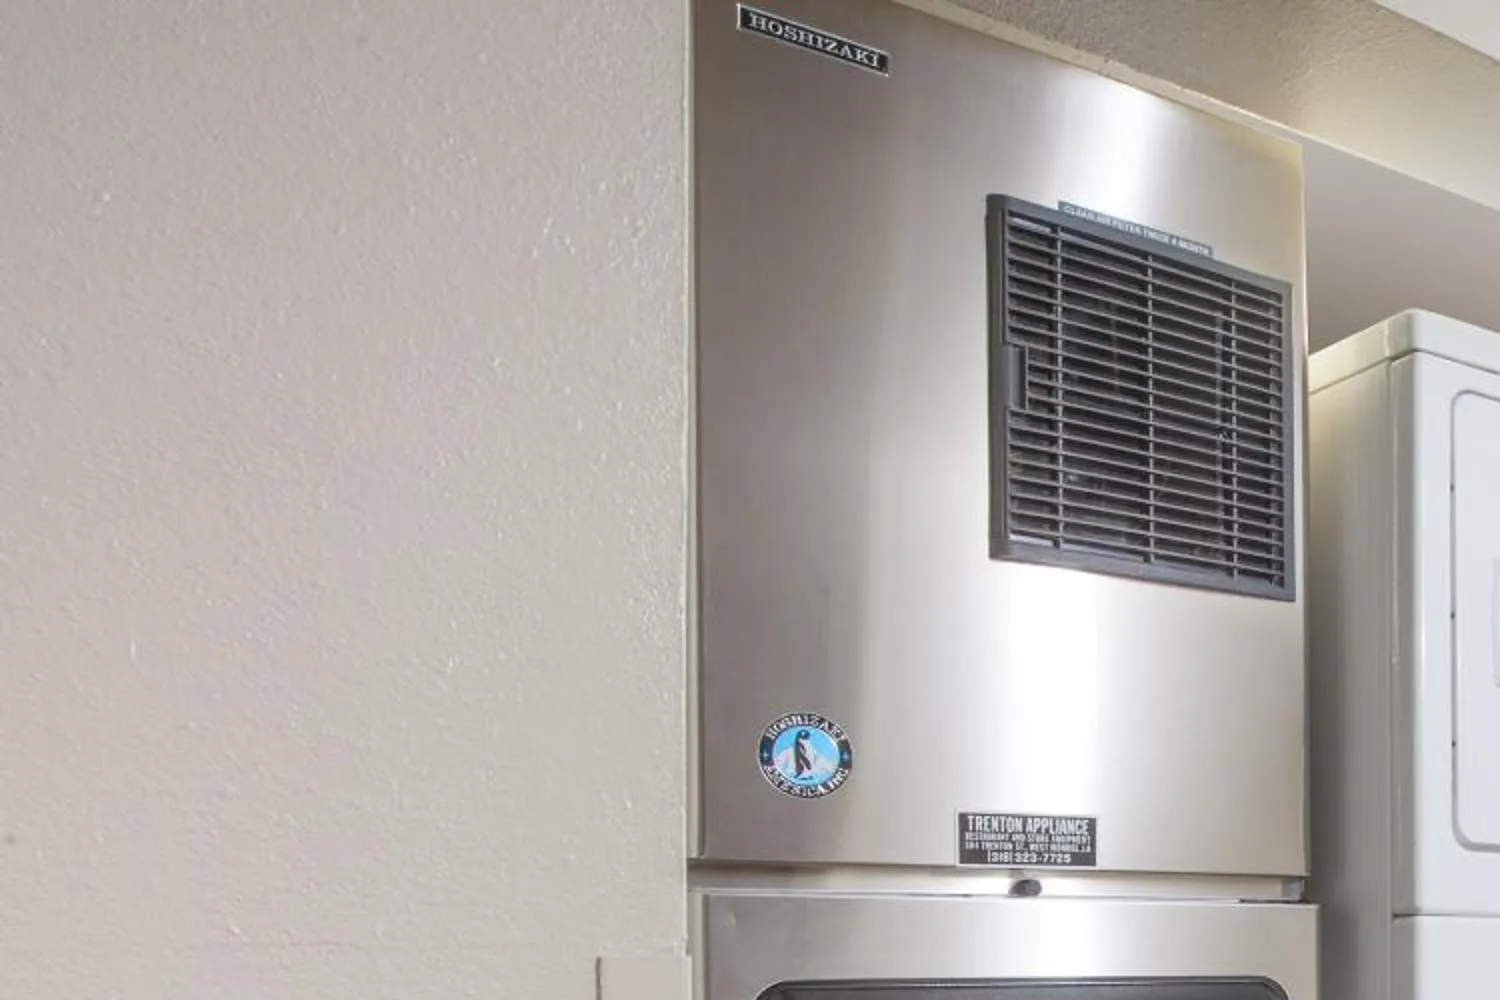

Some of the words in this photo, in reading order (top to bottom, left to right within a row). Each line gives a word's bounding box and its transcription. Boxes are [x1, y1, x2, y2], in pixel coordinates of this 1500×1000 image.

[749, 12, 881, 68] HOSHIZAKI
[967, 815, 1023, 833] TRENTON
[1025, 817, 1089, 836] APPLIANCE
